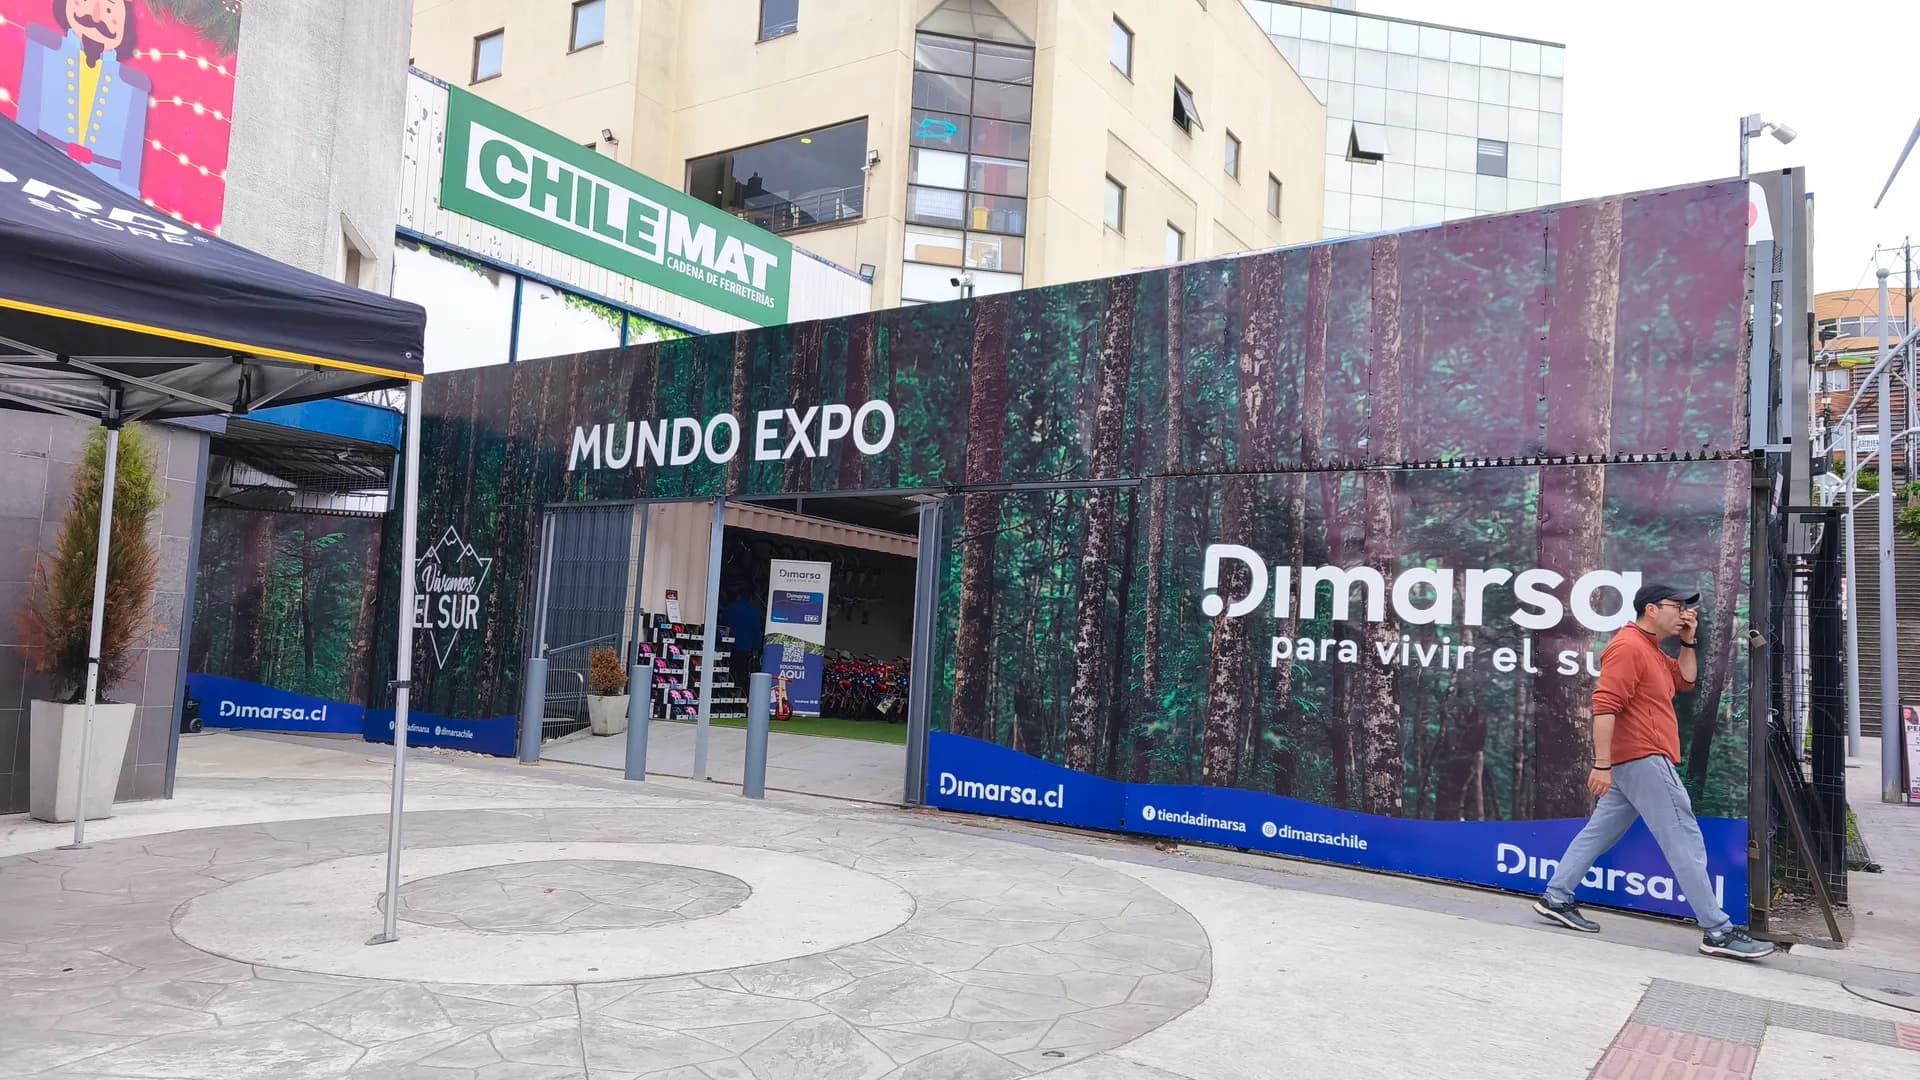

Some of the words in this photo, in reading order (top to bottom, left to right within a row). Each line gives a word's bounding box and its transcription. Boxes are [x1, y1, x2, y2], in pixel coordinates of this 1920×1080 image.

[0, 167, 188, 235] RD
[27, 197, 194, 247] STORE
[478, 138, 778, 291] CHILEMAT
[666, 256, 705, 281] CADENA
[706, 271, 719, 287] DE
[719, 277, 776, 309] FERRETERÍAS
[568, 412, 741, 472] MUNDO
[754, 398, 896, 462] EXPO
[421, 563, 477, 594] Vivamos
[779, 569, 821, 579] Dimarsa
[1201, 543, 1643, 632] Dimarsa
[413, 594, 434, 629] EL
[437, 594, 480, 630] SUR
[1271, 636, 1358, 668] para
[1376, 635, 1476, 670] vivir
[1492, 638, 1537, 674] el
[1556, 649, 1601, 678] su
[219, 700, 328, 721] Dimarsa.cl
[940, 772, 1064, 808] Dimarsa.cl
[1158, 808, 1247, 833] tiendadimarsa
[1278, 825, 1368, 850] dimarsachile
[1497, 843, 1725, 908] Diarsa.l
